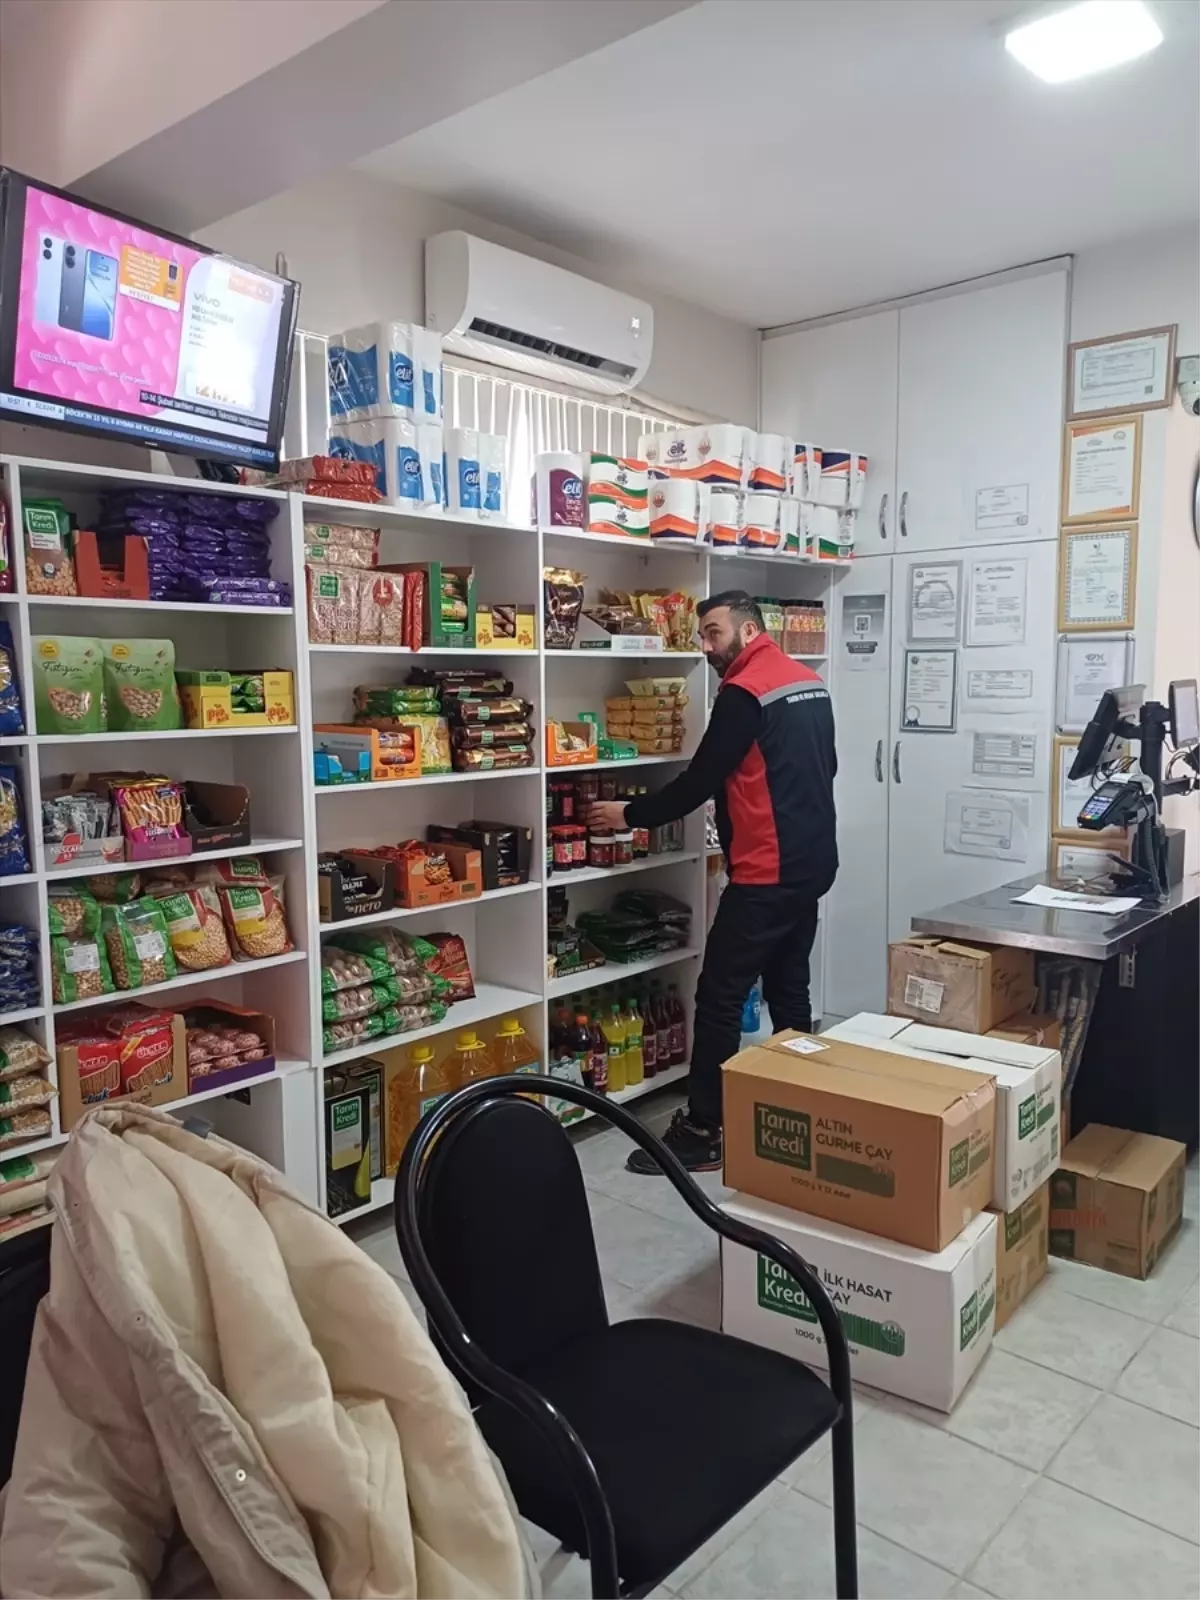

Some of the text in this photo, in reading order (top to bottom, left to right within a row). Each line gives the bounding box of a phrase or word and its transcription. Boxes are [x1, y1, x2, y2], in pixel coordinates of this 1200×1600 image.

[335, 1101, 358, 1114] Tarım
[336, 1111, 358, 1125] Kredi
[757, 1106, 808, 1137] Tarım
[815, 1117, 853, 1135] ALTIN
[760, 1128, 805, 1158] Kredi
[815, 1132, 894, 1161] GURME ÇAY
[760, 1254, 797, 1283] Tar
[823, 1268, 893, 1303] İLK HASAT
[794, 1327, 815, 1340] 1000
